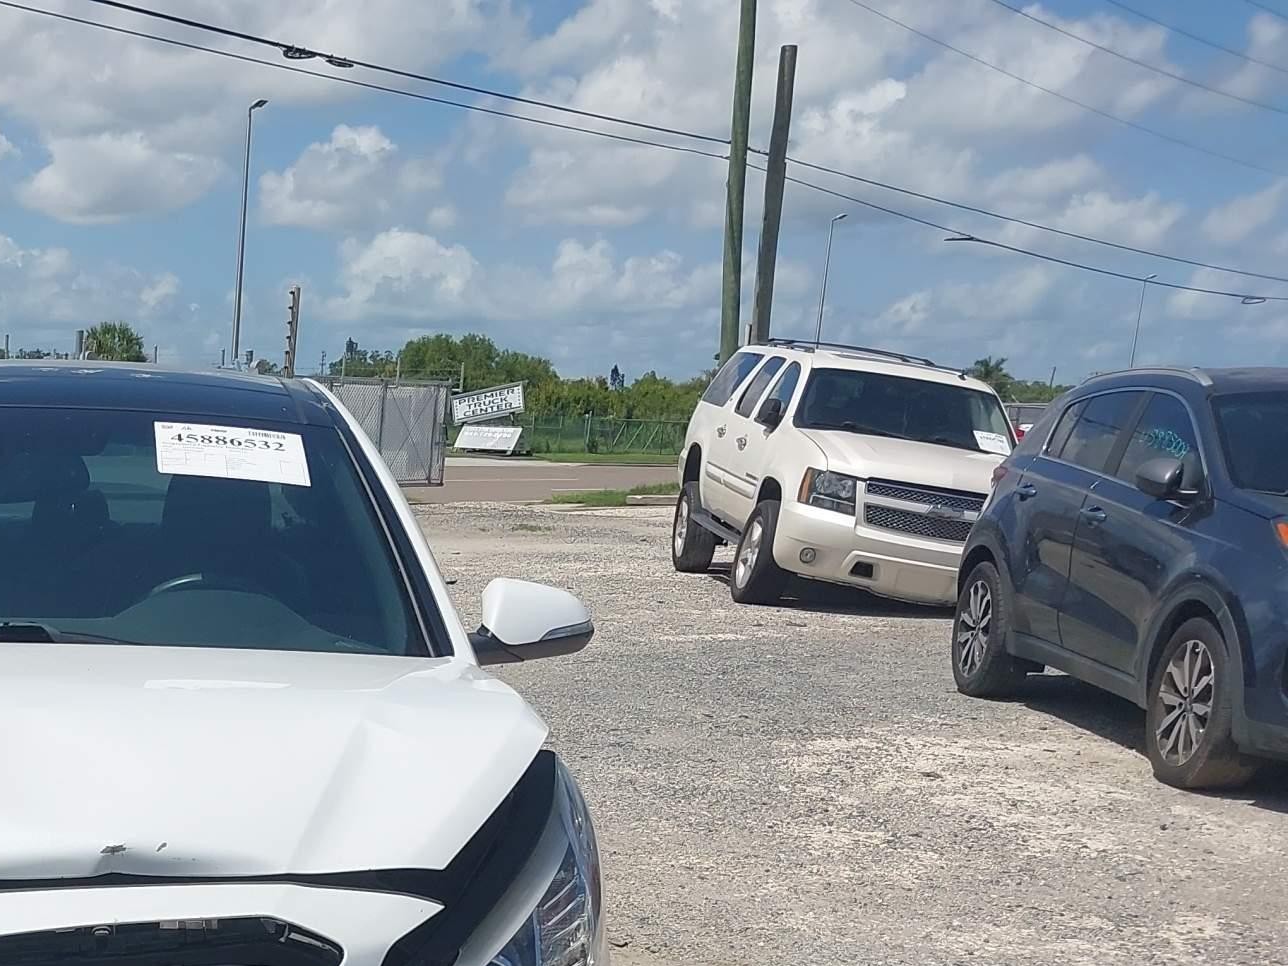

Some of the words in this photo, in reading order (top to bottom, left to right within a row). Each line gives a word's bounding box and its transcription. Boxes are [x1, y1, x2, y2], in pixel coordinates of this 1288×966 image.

[458, 388, 515, 406] PREMIER
[466, 397, 508, 410] TRUCK
[463, 402, 513, 417] CENTER
[170, 433, 286, 452] 45886532
